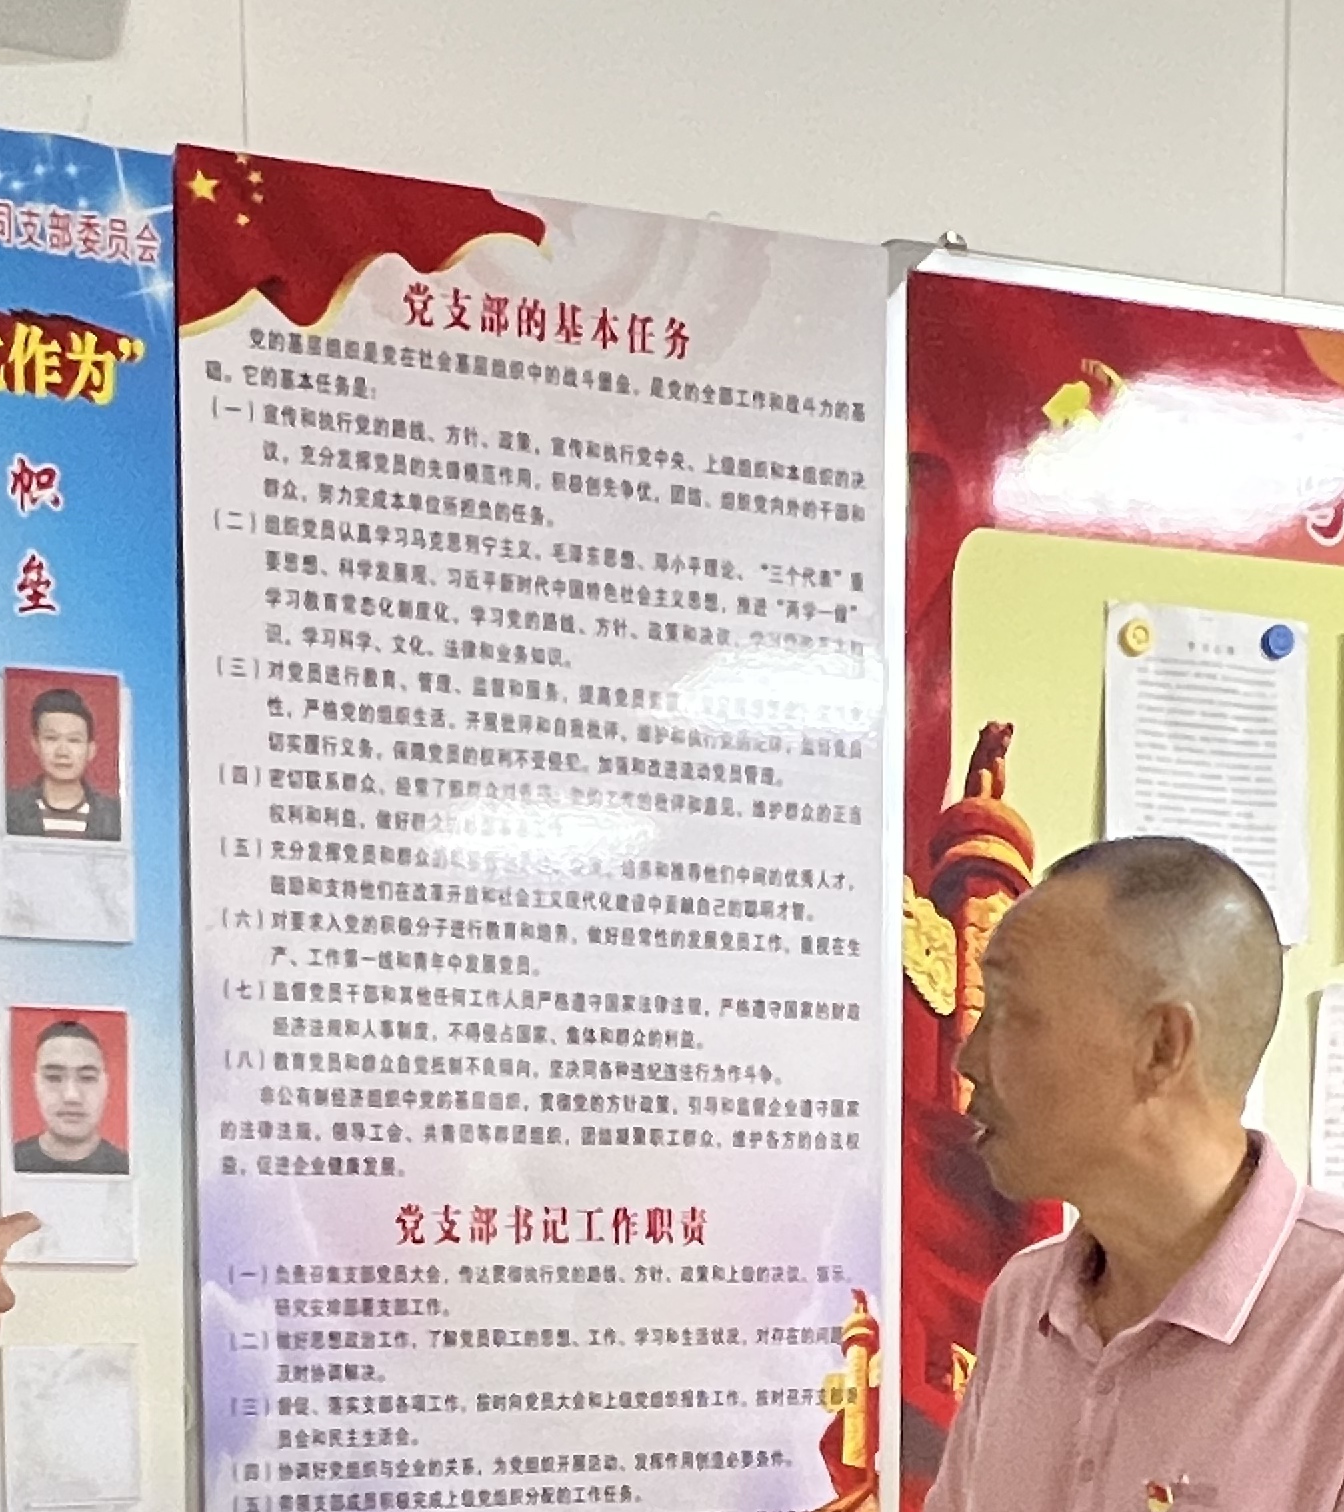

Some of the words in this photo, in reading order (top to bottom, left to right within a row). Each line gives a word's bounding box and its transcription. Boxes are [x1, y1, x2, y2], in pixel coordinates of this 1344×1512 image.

[403, 282, 690, 359] 党支部的基本任务
[395, 1203, 707, 1246] 党支部书记工作职责
